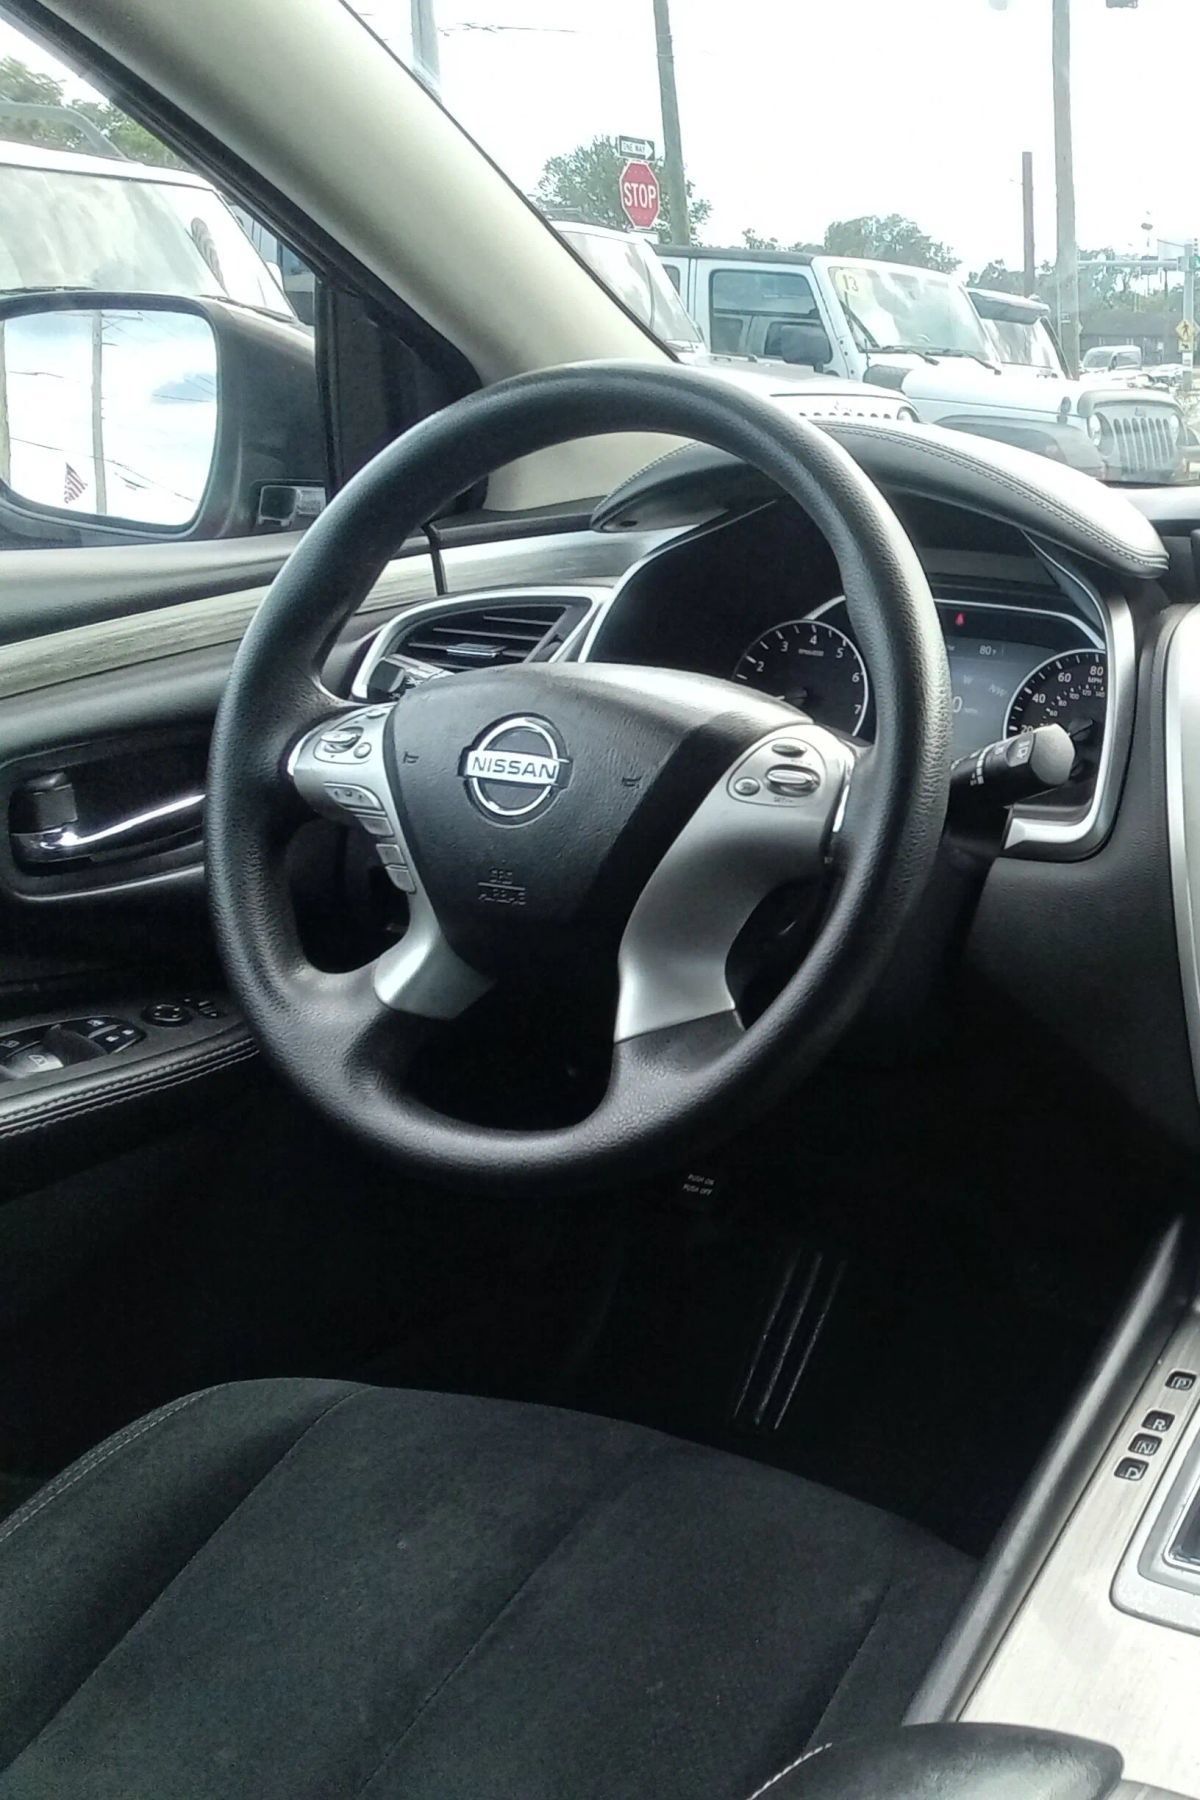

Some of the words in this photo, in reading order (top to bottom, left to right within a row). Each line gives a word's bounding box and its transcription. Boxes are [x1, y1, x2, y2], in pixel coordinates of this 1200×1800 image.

[622, 142, 633, 152] ONE
[635, 144, 646, 153] WAY
[624, 182, 656, 209] STOP
[842, 274, 859, 292] 13
[809, 635, 818, 645] 4
[780, 641, 789, 652] 3
[836, 648, 844, 659] 5
[756, 661, 765, 672] 2
[1089, 665, 1103, 676] 80
[852, 672, 860, 682] 6
[1057, 672, 1071, 683] 60
[1087, 676, 1103, 684] MPH
[1032, 693, 1046, 704] 40
[854, 704, 862, 715] 7
[1020, 724, 1034, 735] 20
[472, 756, 557, 779] NISSAN
[1152, 1418, 1166, 1431] R
[1139, 1443, 1152, 1455] N
